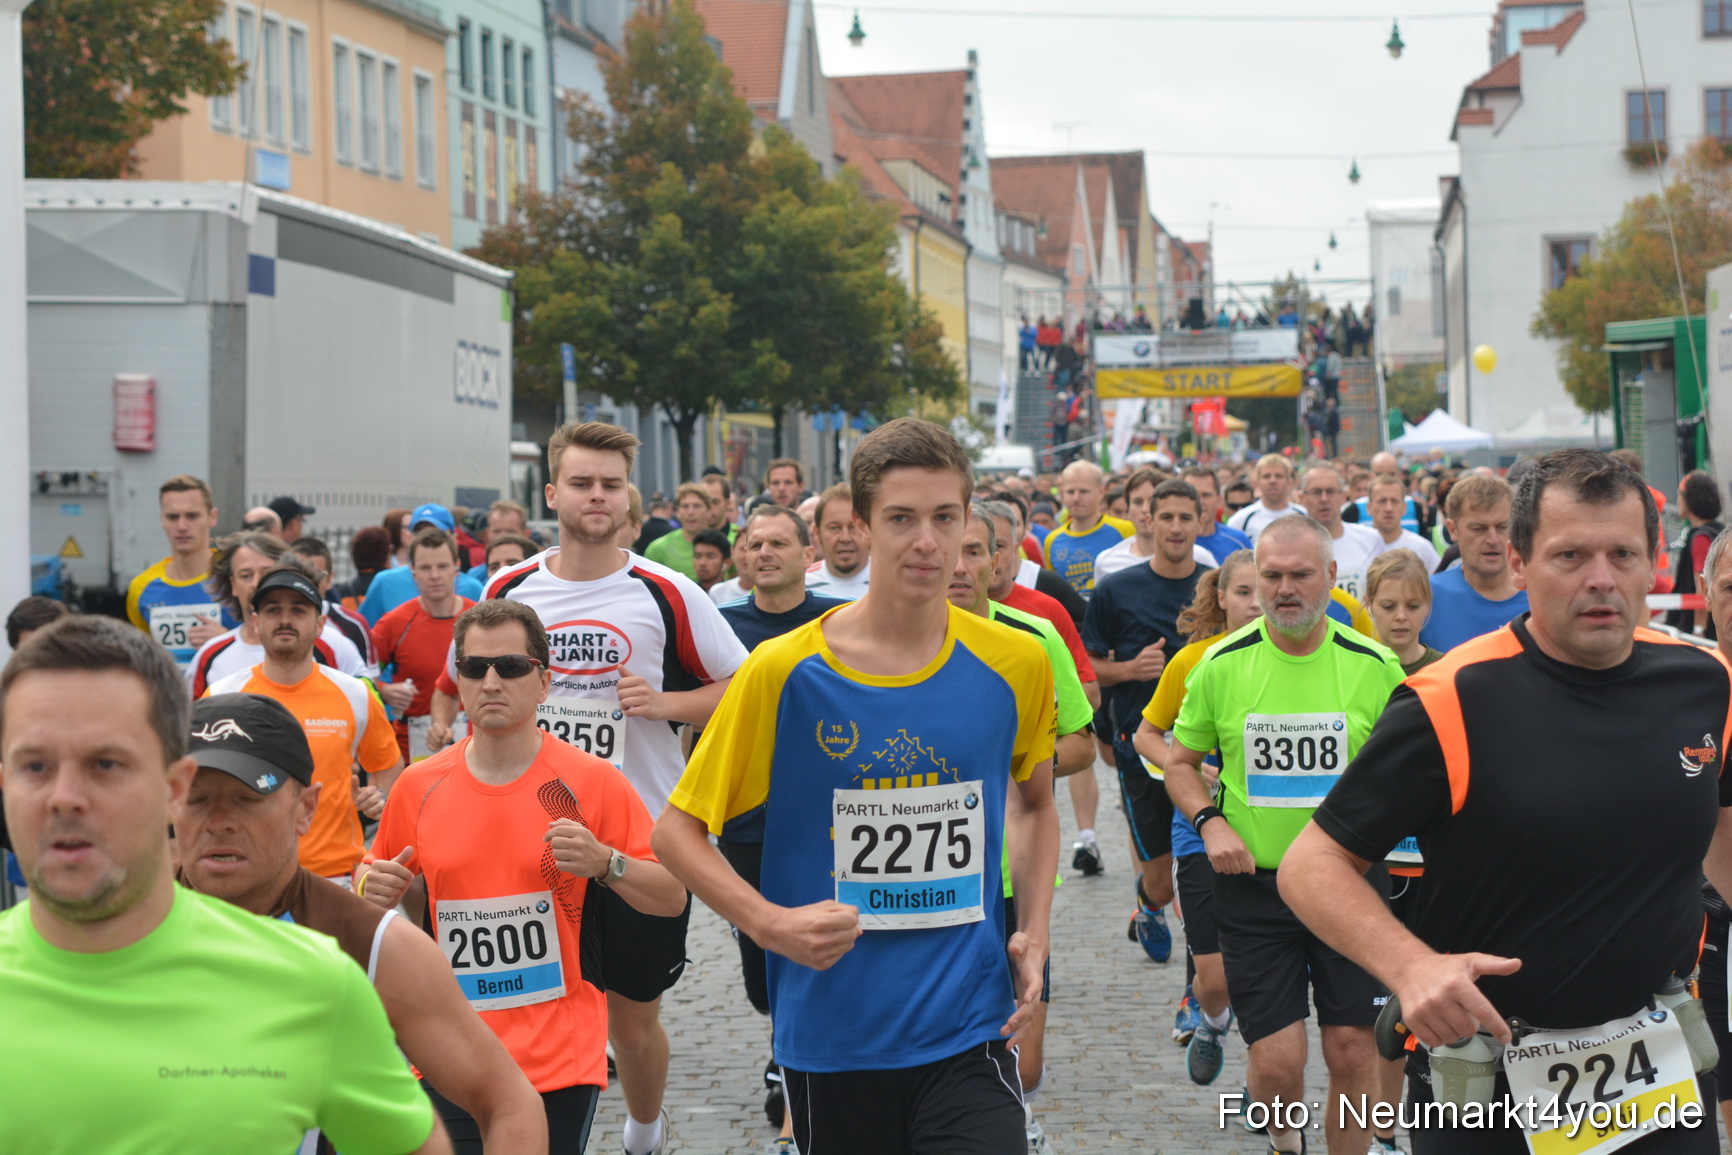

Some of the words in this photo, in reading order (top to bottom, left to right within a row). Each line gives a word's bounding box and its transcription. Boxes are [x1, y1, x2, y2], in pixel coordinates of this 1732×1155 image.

[1163, 373, 1233, 391] START
[609, 638, 618, 648] &
[560, 707, 607, 718] Neumarkt
[831, 725, 842, 733] 15
[1246, 722, 1277, 732] PARTL
[1280, 722, 1329, 732] Neumarkt
[825, 736, 850, 745] Jahre
[1254, 735, 1338, 771] 3308
[836, 803, 888, 817] PARTL
[892, 798, 959, 816] Neumarkt
[851, 818, 971, 874] 2275
[869, 888, 956, 909] Christian
[438, 911, 472, 922] PARTL
[474, 905, 531, 921] Neumarkt
[448, 920, 548, 969] 2600
[477, 974, 524, 995] Bernd
[1506, 1042, 1565, 1064] PARTL
[159, 1066, 287, 1080] Dorfner-Apotheken
[1547, 1039, 1659, 1116] 224
